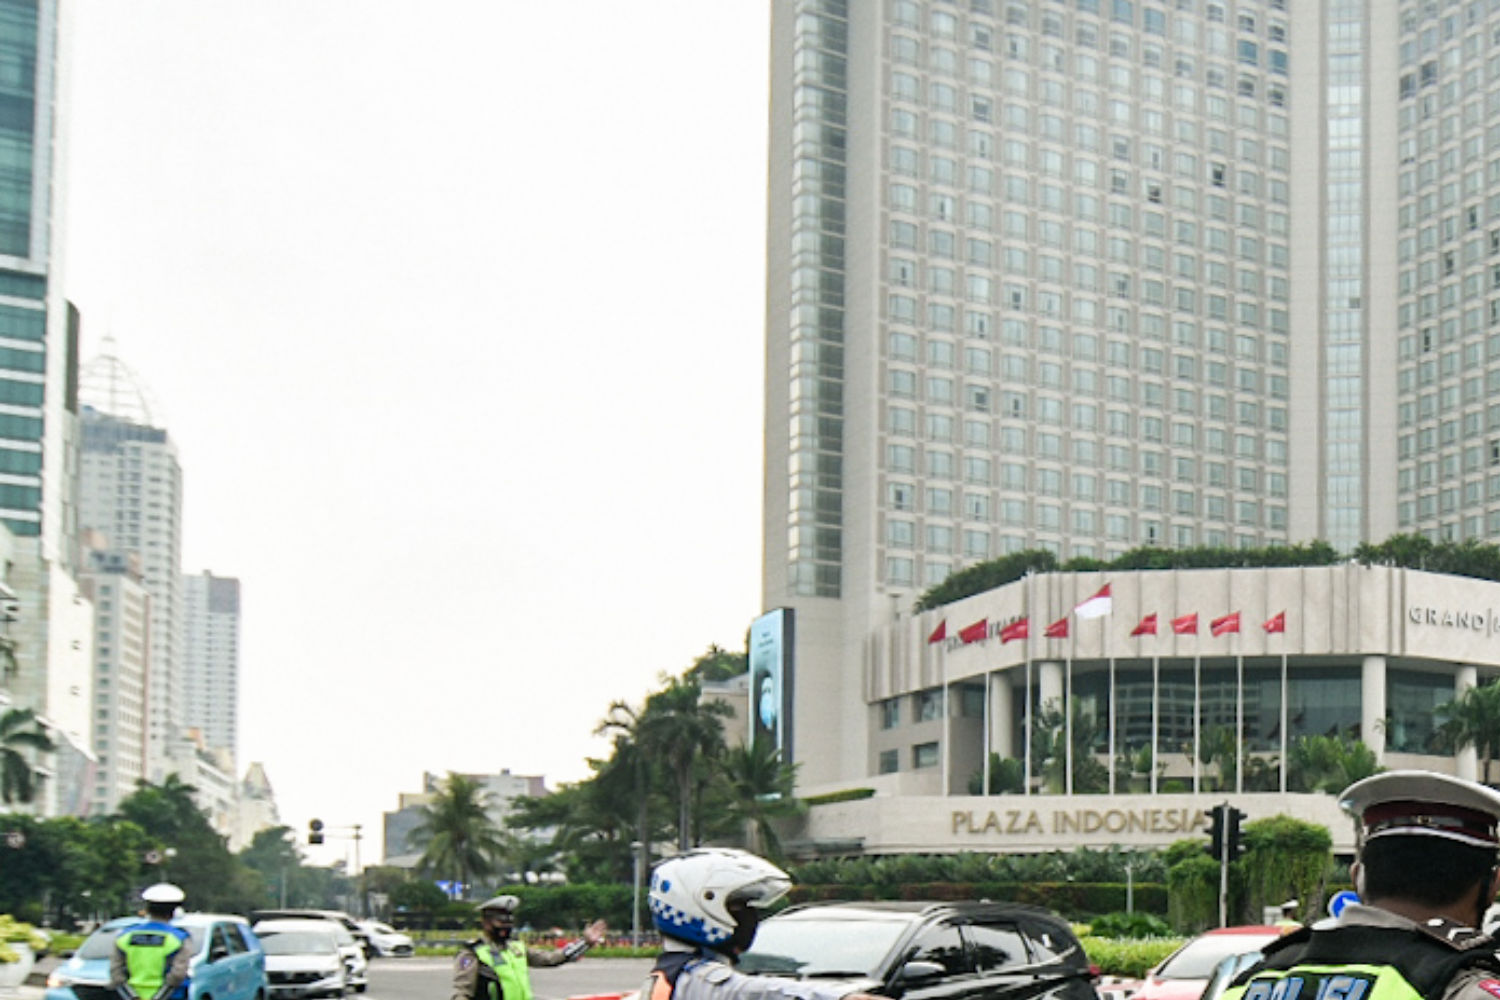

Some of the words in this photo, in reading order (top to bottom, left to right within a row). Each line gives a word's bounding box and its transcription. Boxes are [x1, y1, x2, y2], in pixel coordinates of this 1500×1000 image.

[1409, 607, 1484, 631] GRAND
[952, 809, 1044, 835] PLAZA
[1053, 809, 1209, 835] INDONESIA
